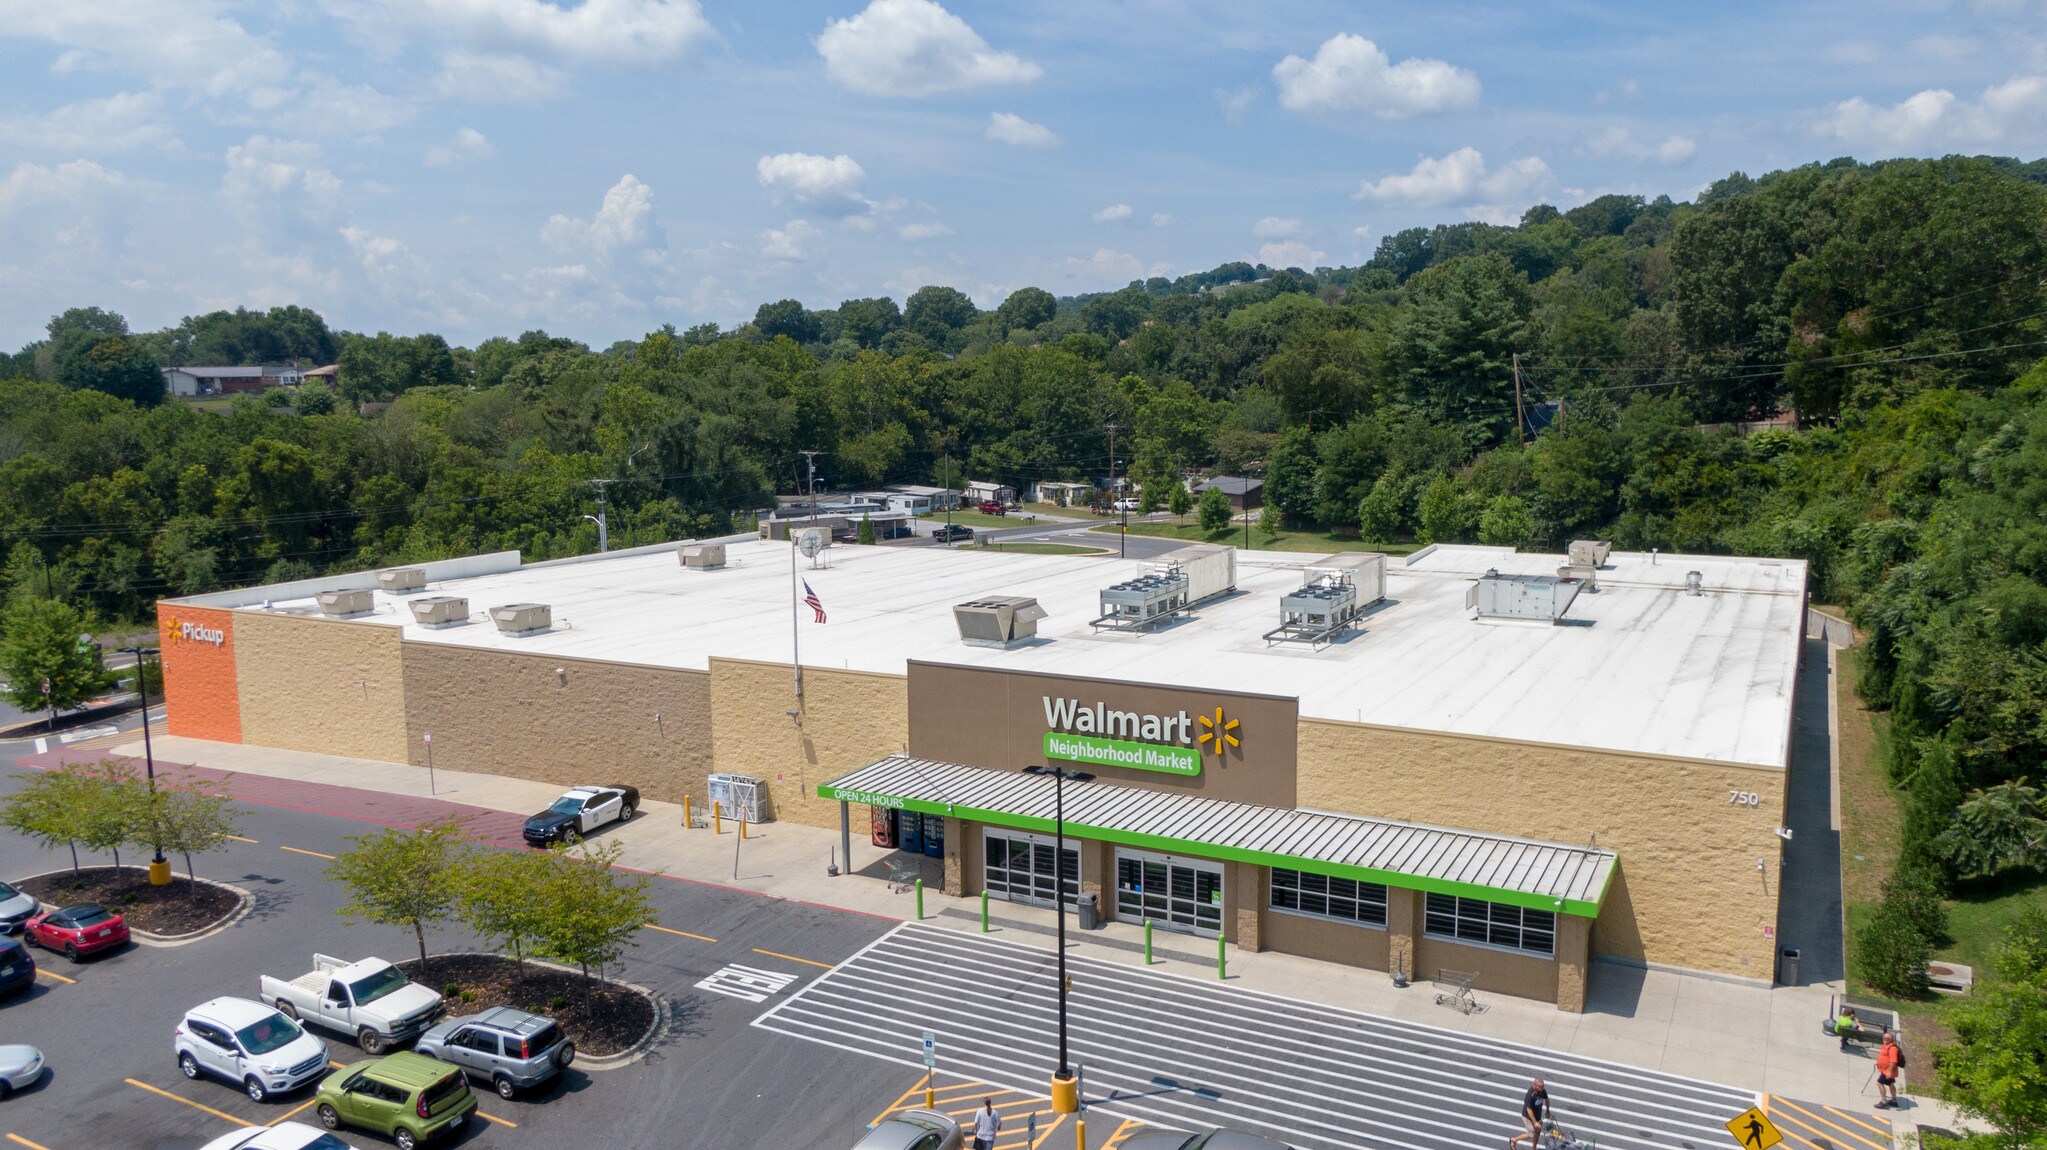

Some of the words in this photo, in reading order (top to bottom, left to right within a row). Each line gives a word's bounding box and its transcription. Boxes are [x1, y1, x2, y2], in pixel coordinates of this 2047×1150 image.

[183, 622, 224, 647] Pickup
[1043, 696, 1191, 744] Walmart
[1050, 738, 1142, 764] Neighborhood
[1146, 750, 1193, 770] Market
[834, 789, 858, 802] OPEN
[860, 793, 871, 804] 24
[872, 795, 904, 808] HOURS
[1729, 790, 1759, 805] 750
[693, 963, 799, 1003] YIELD
